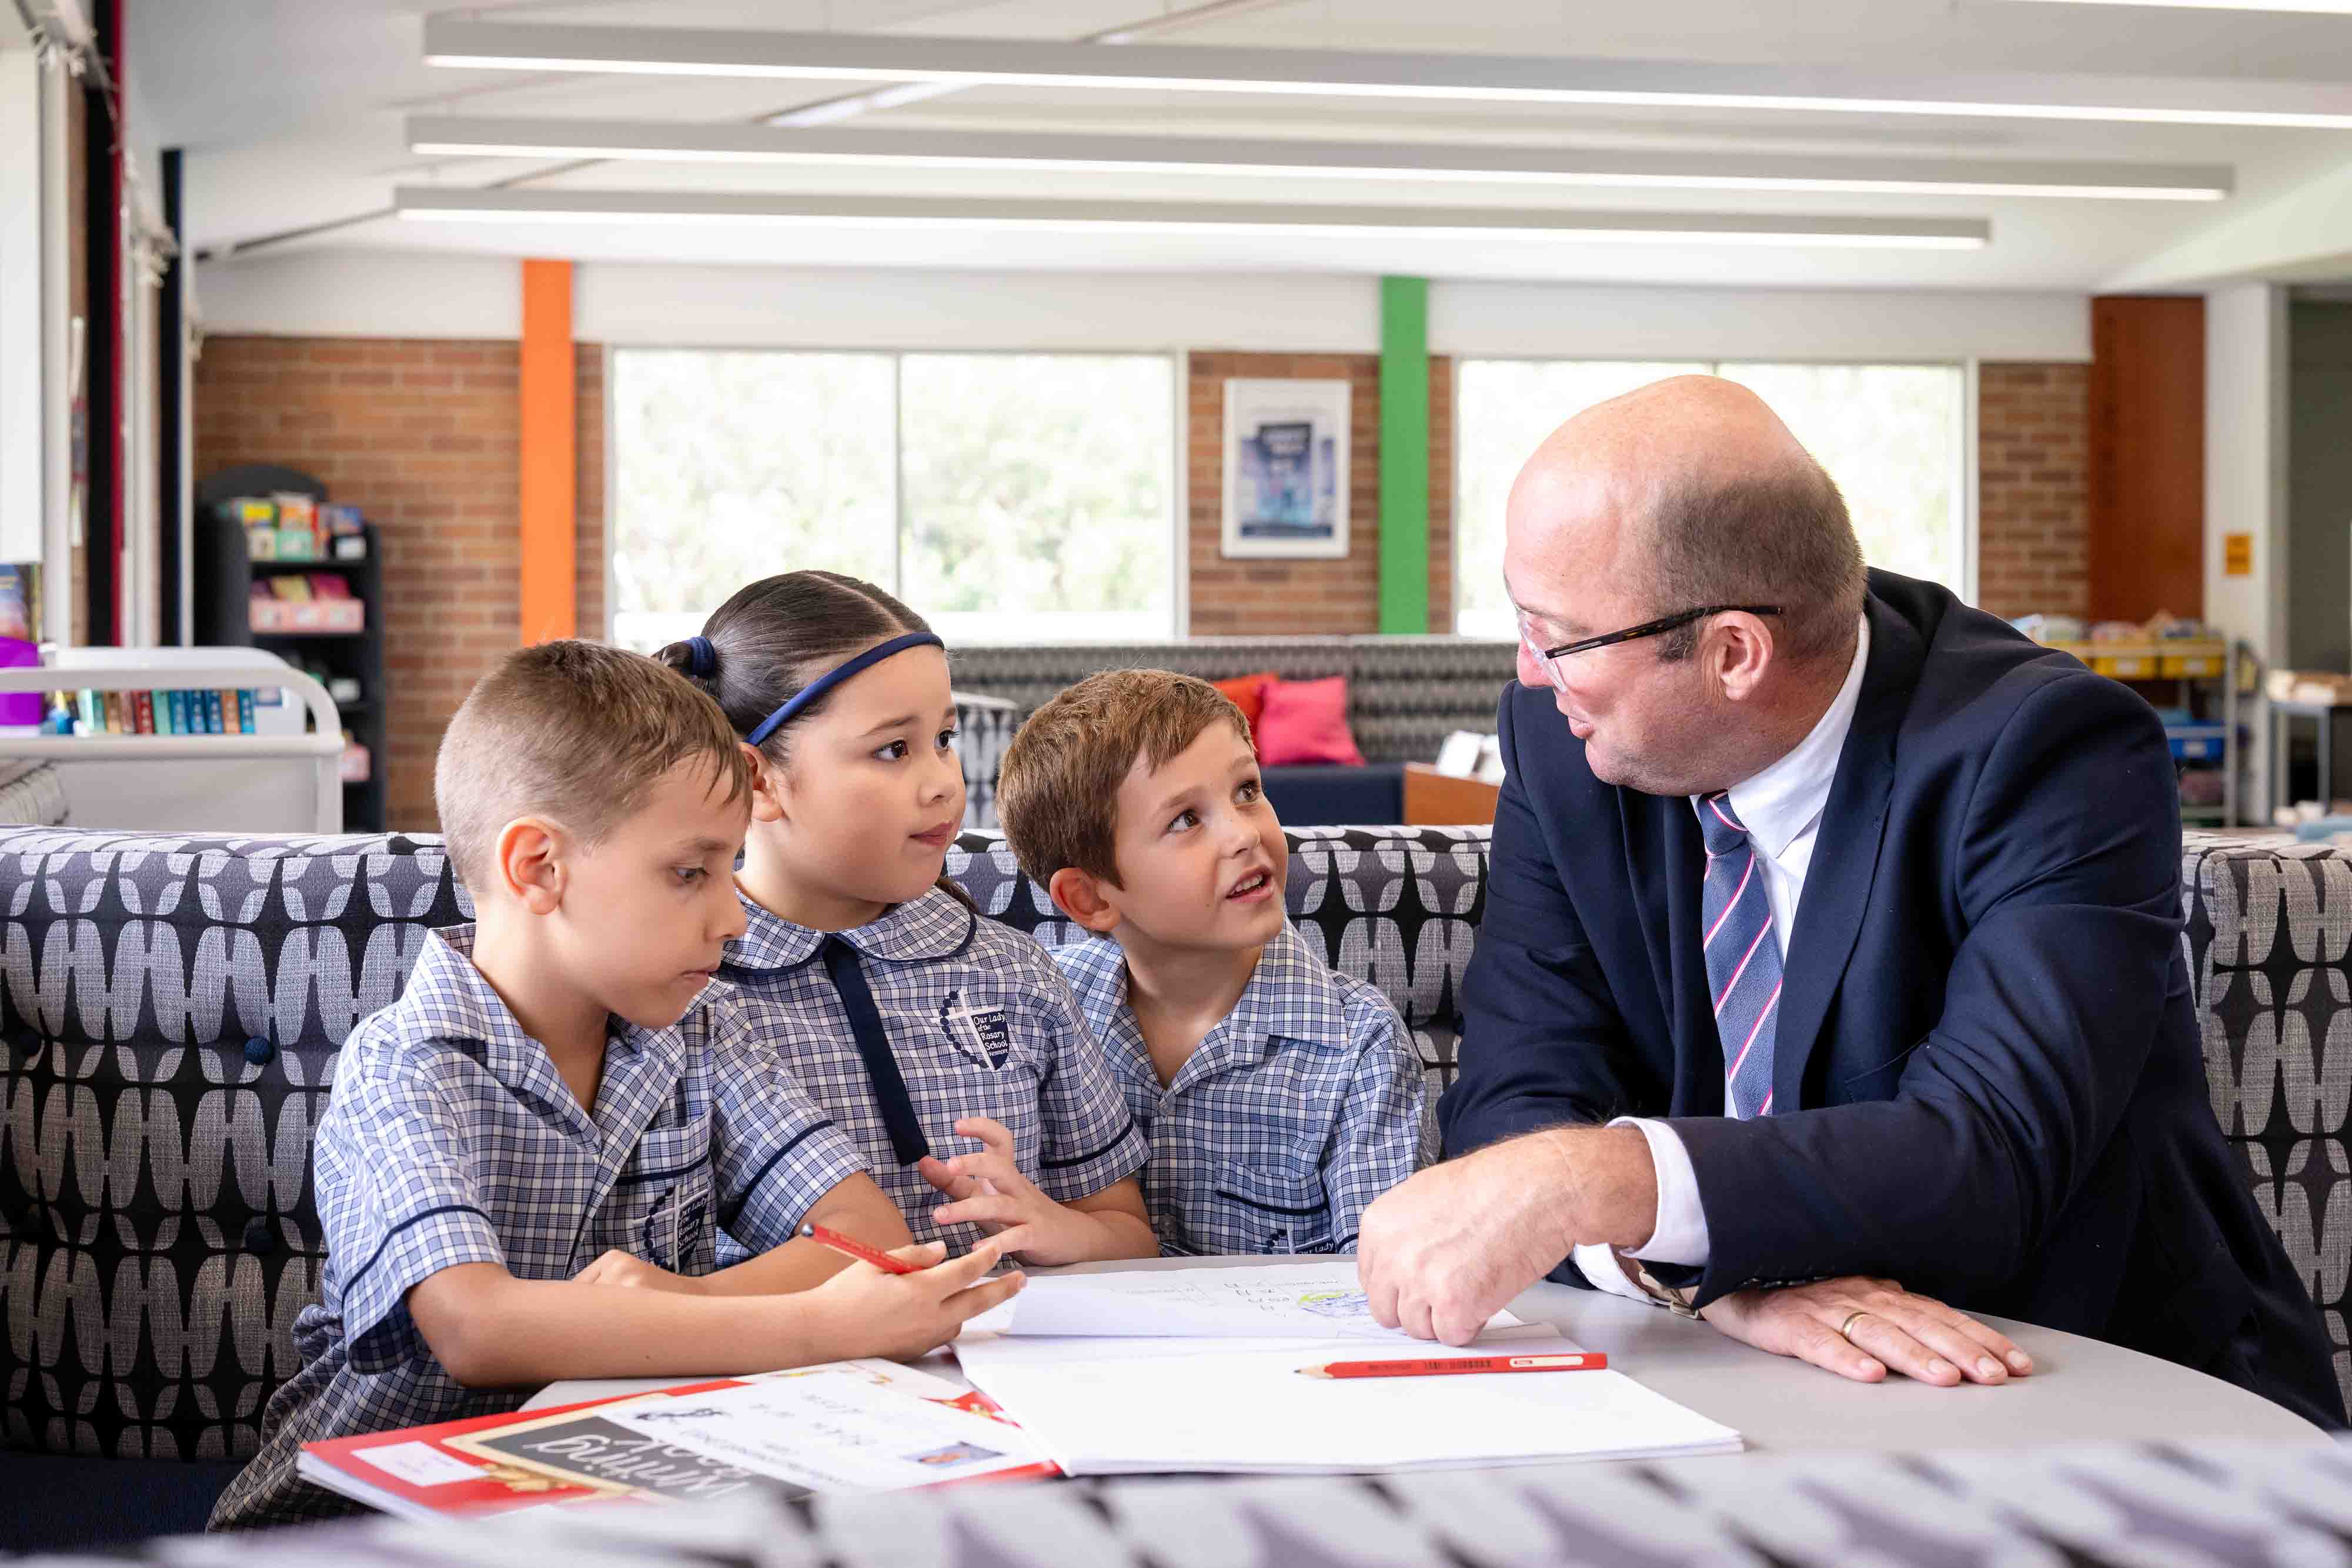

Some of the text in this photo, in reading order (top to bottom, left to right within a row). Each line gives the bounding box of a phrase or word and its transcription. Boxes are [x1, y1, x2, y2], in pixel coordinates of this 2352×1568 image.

[973, 1012, 1005, 1025] Our Lady
[980, 1031, 1004, 1041] Rosary
[984, 1039, 1008, 1051] School
[1315, 1242, 1334, 1253] Lady
